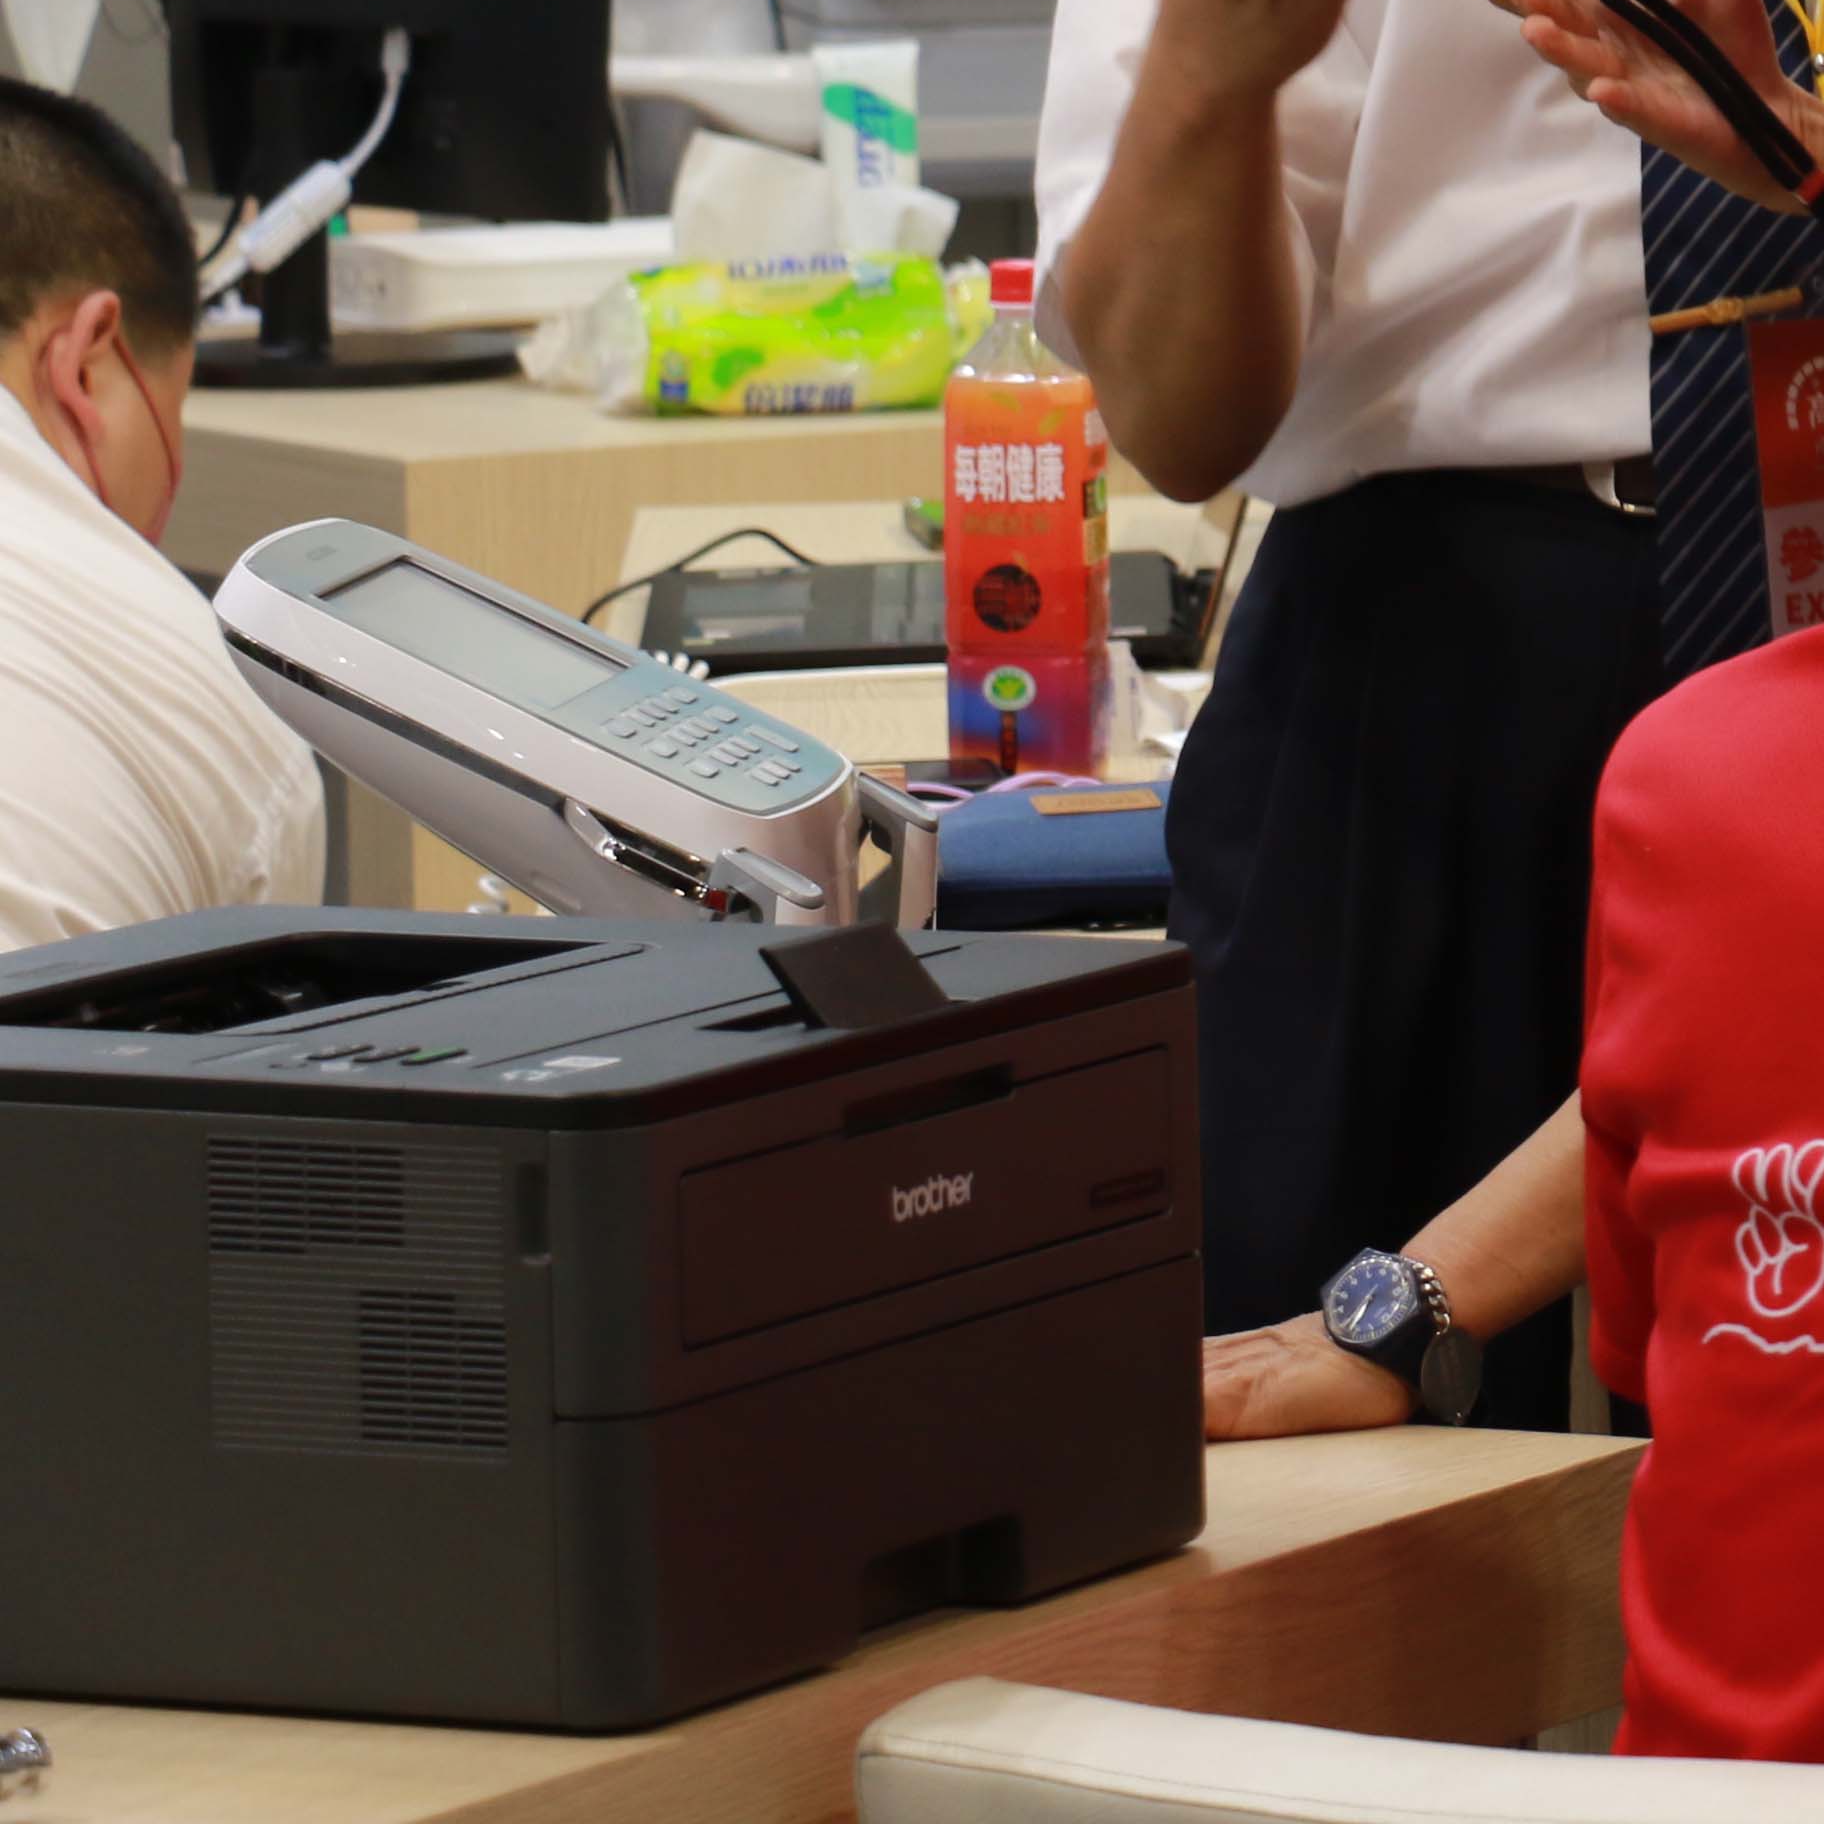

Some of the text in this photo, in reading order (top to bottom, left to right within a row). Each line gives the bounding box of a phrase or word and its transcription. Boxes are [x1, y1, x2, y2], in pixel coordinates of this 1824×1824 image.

[955, 442, 1066, 504] 每朝健康
[892, 1171, 974, 1223] brother
